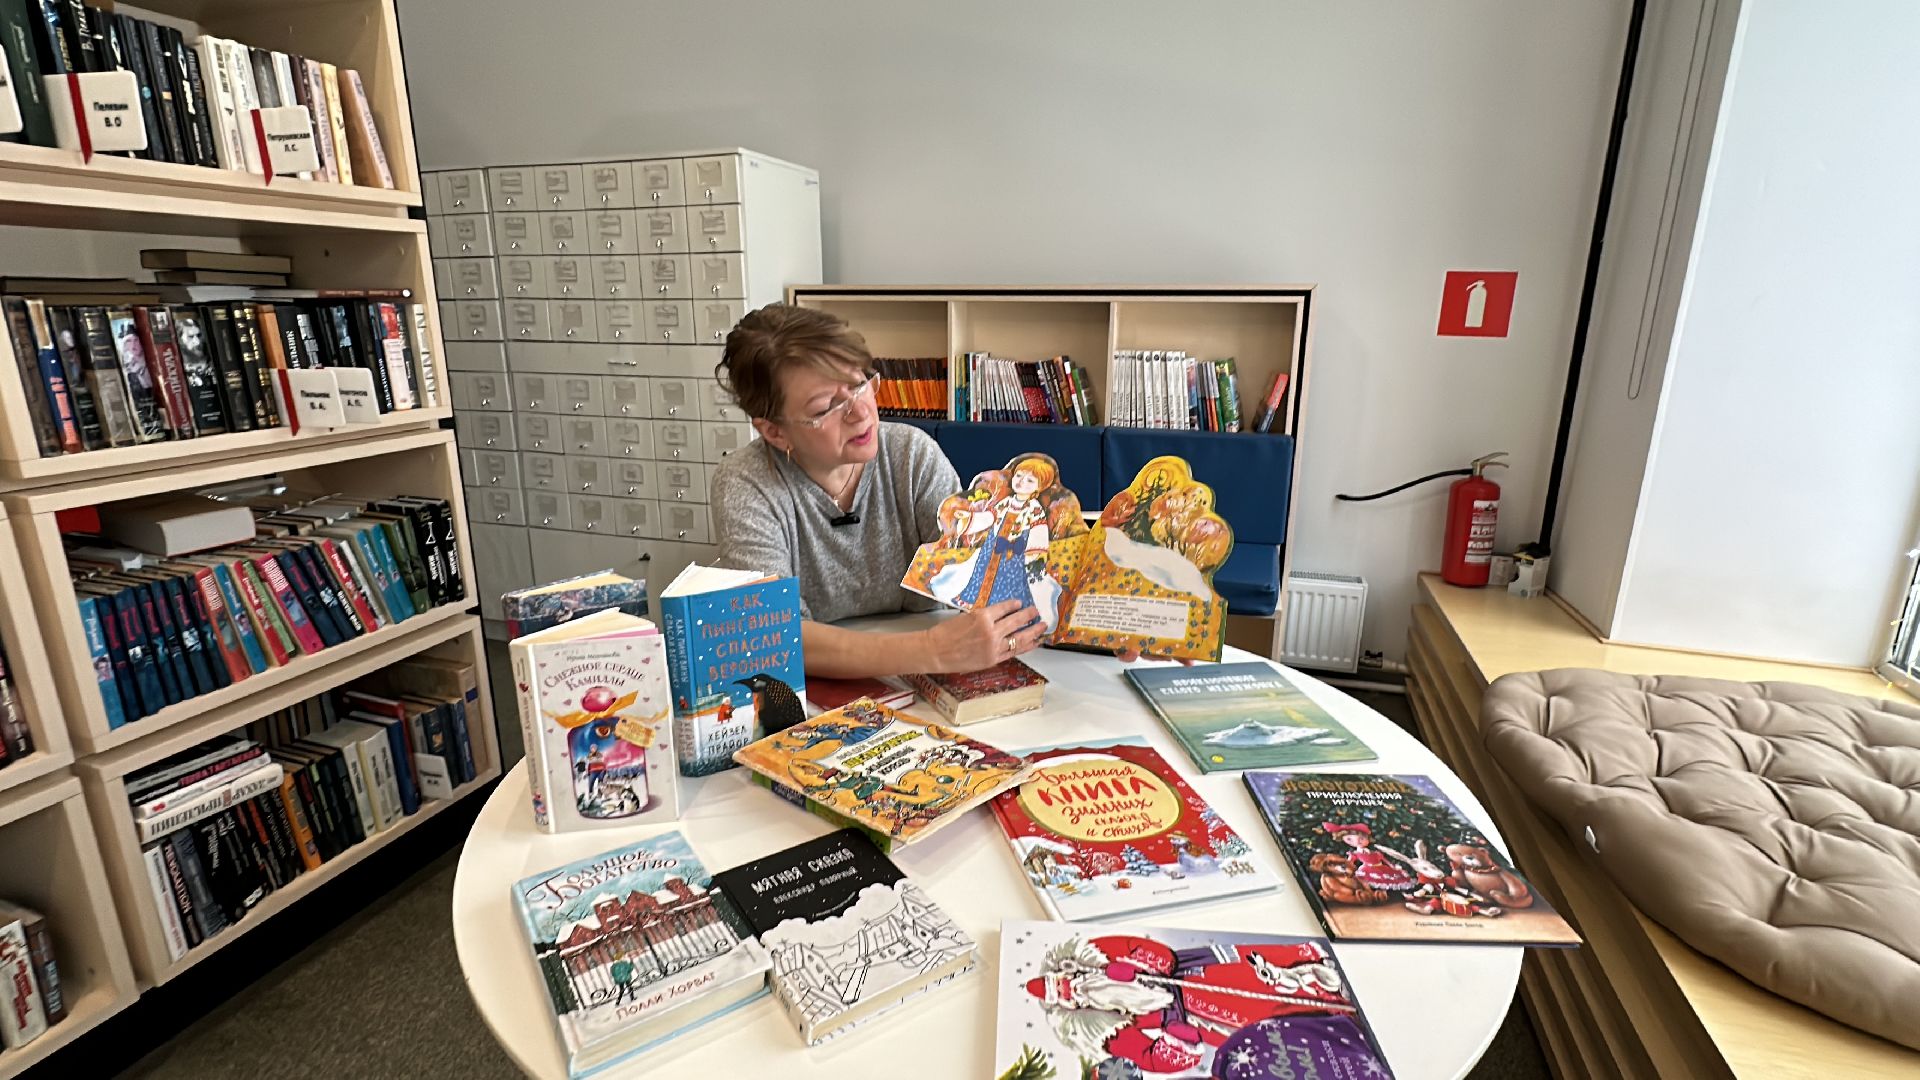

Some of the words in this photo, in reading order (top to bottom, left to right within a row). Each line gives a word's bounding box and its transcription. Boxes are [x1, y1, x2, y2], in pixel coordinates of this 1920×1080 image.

[93, 101, 129, 111] Пелевин
[730, 593, 764, 612] КАК
[702, 607, 792, 640] ПИНГВИНЫ
[716, 631, 782, 659] СПАСЛИ
[709, 650, 790, 682] ВЕРОНИКУ
[708, 725, 748, 742] ХЕЙЗЕЛ
[1306, 791, 1403, 800] ПРИКЛЮЧЕНИЯ
[1061, 798, 1153, 825] зимних
[1086, 827, 1098, 837] и
[1102, 812, 1163, 838] стихов
[164, 842, 193, 914] REVOLUTION
[751, 866, 804, 894] МЯТНАЯ
[807, 847, 855, 872] СКАЗКА
[667, 971, 716, 999] ХОРВАТ
